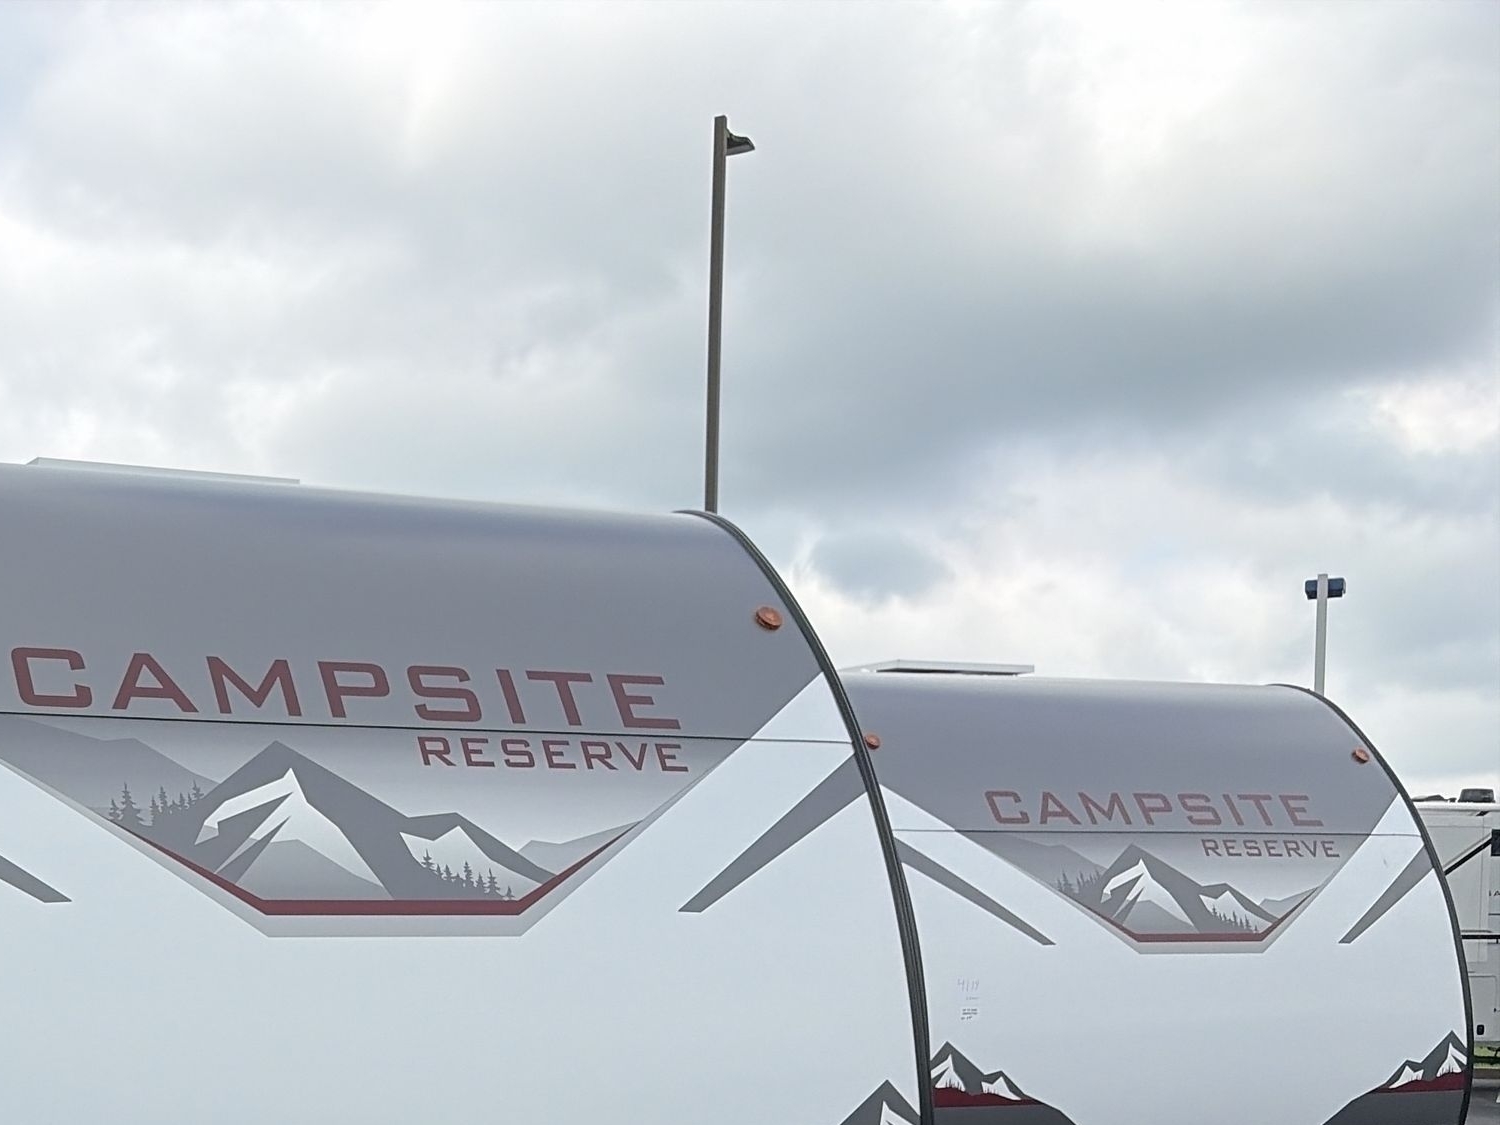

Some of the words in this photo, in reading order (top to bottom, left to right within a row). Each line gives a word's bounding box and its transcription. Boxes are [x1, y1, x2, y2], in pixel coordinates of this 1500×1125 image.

[10, 647, 682, 730] CAMPSITE
[417, 736, 689, 772] RESERVE
[984, 791, 1325, 827] CAMPSITE
[1202, 838, 1340, 858] RESERVE
